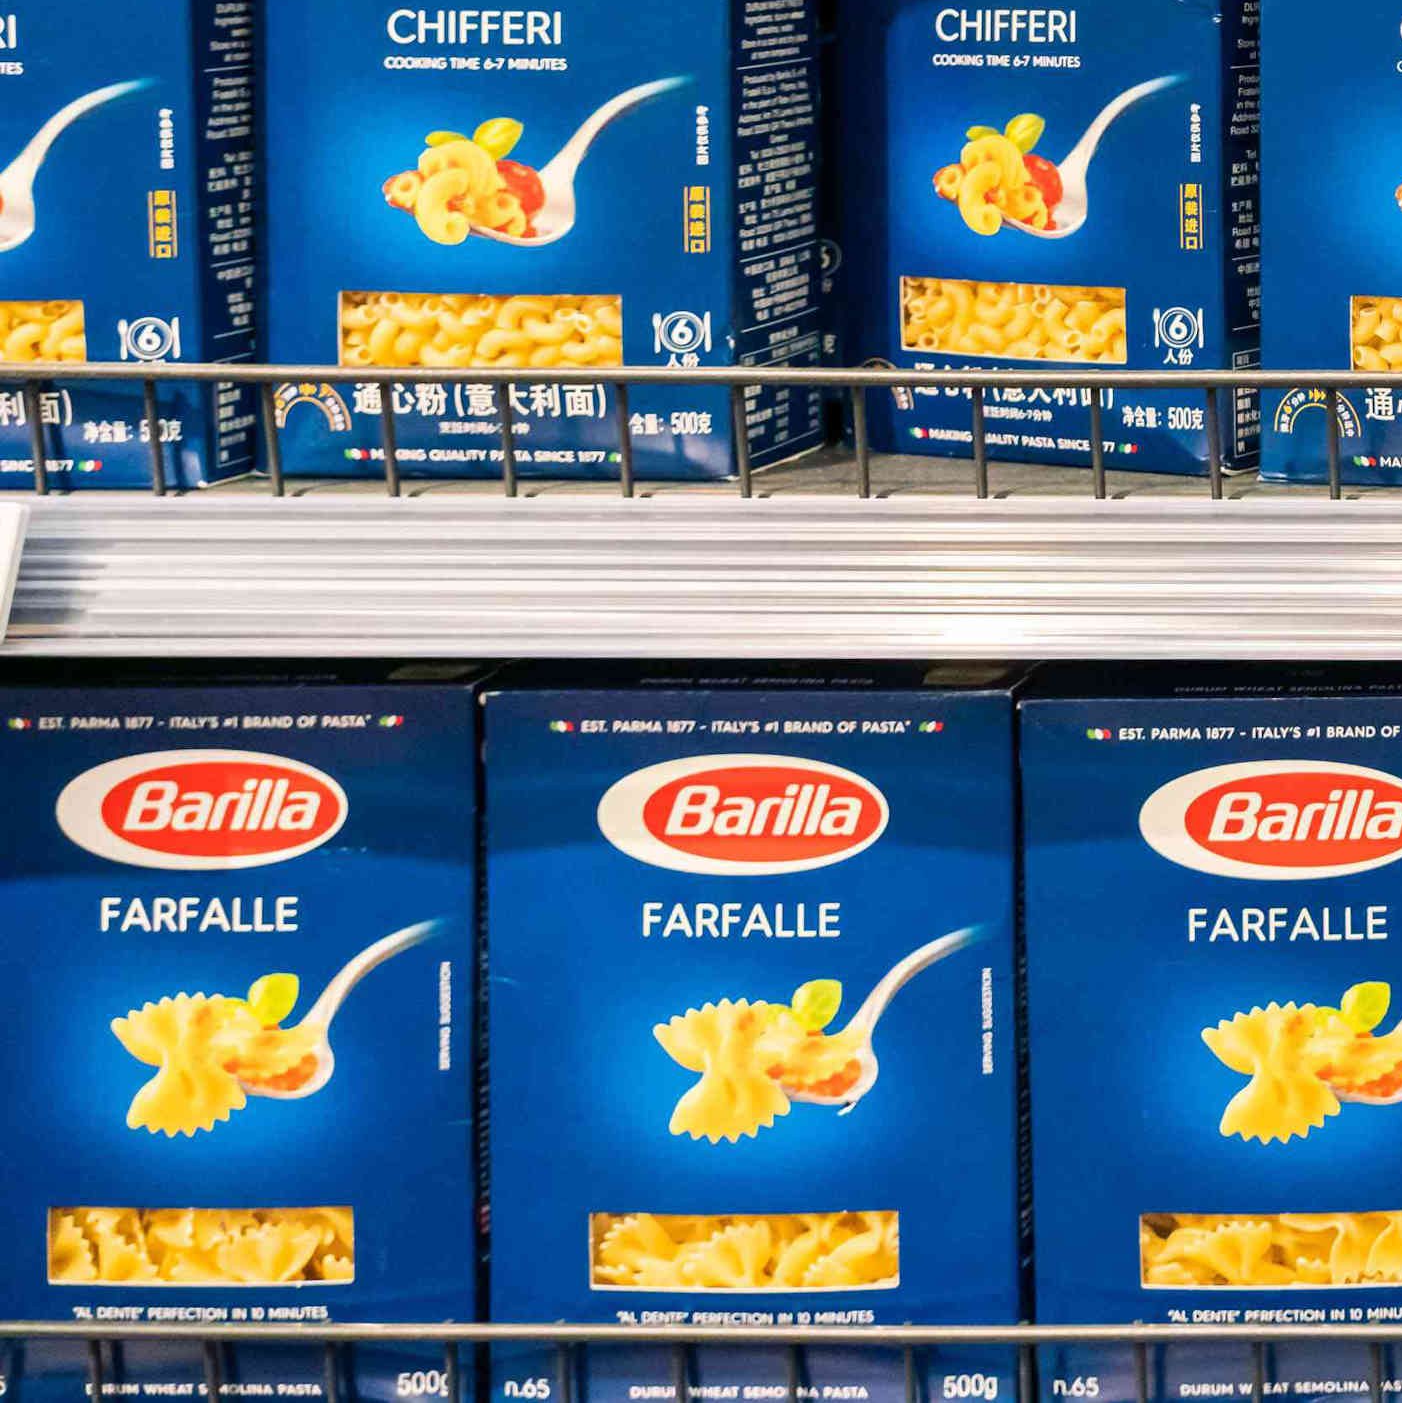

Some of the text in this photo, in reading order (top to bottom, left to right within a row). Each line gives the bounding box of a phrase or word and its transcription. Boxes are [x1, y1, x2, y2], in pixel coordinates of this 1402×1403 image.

[387, 9, 561, 44] CHIFFERI
[936, 9, 1075, 42] CHIFFERI
[933, 54, 1080, 67] COOKING TIME 6-7 MINUTES
[1163, 349, 1193, 365] 人份
[1168, 407, 1204, 430] 500克
[123, 779, 321, 831] Barilla
[664, 784, 862, 837] Barilla
[101, 897, 298, 932] FARFALLE
[643, 903, 840, 937] FARFALLE
[1189, 906, 1387, 942] FARFALLE
[504, 1379, 550, 1399] n.65
[943, 1374, 997, 1400] 500g
[1054, 1377, 1102, 1400] n.65
